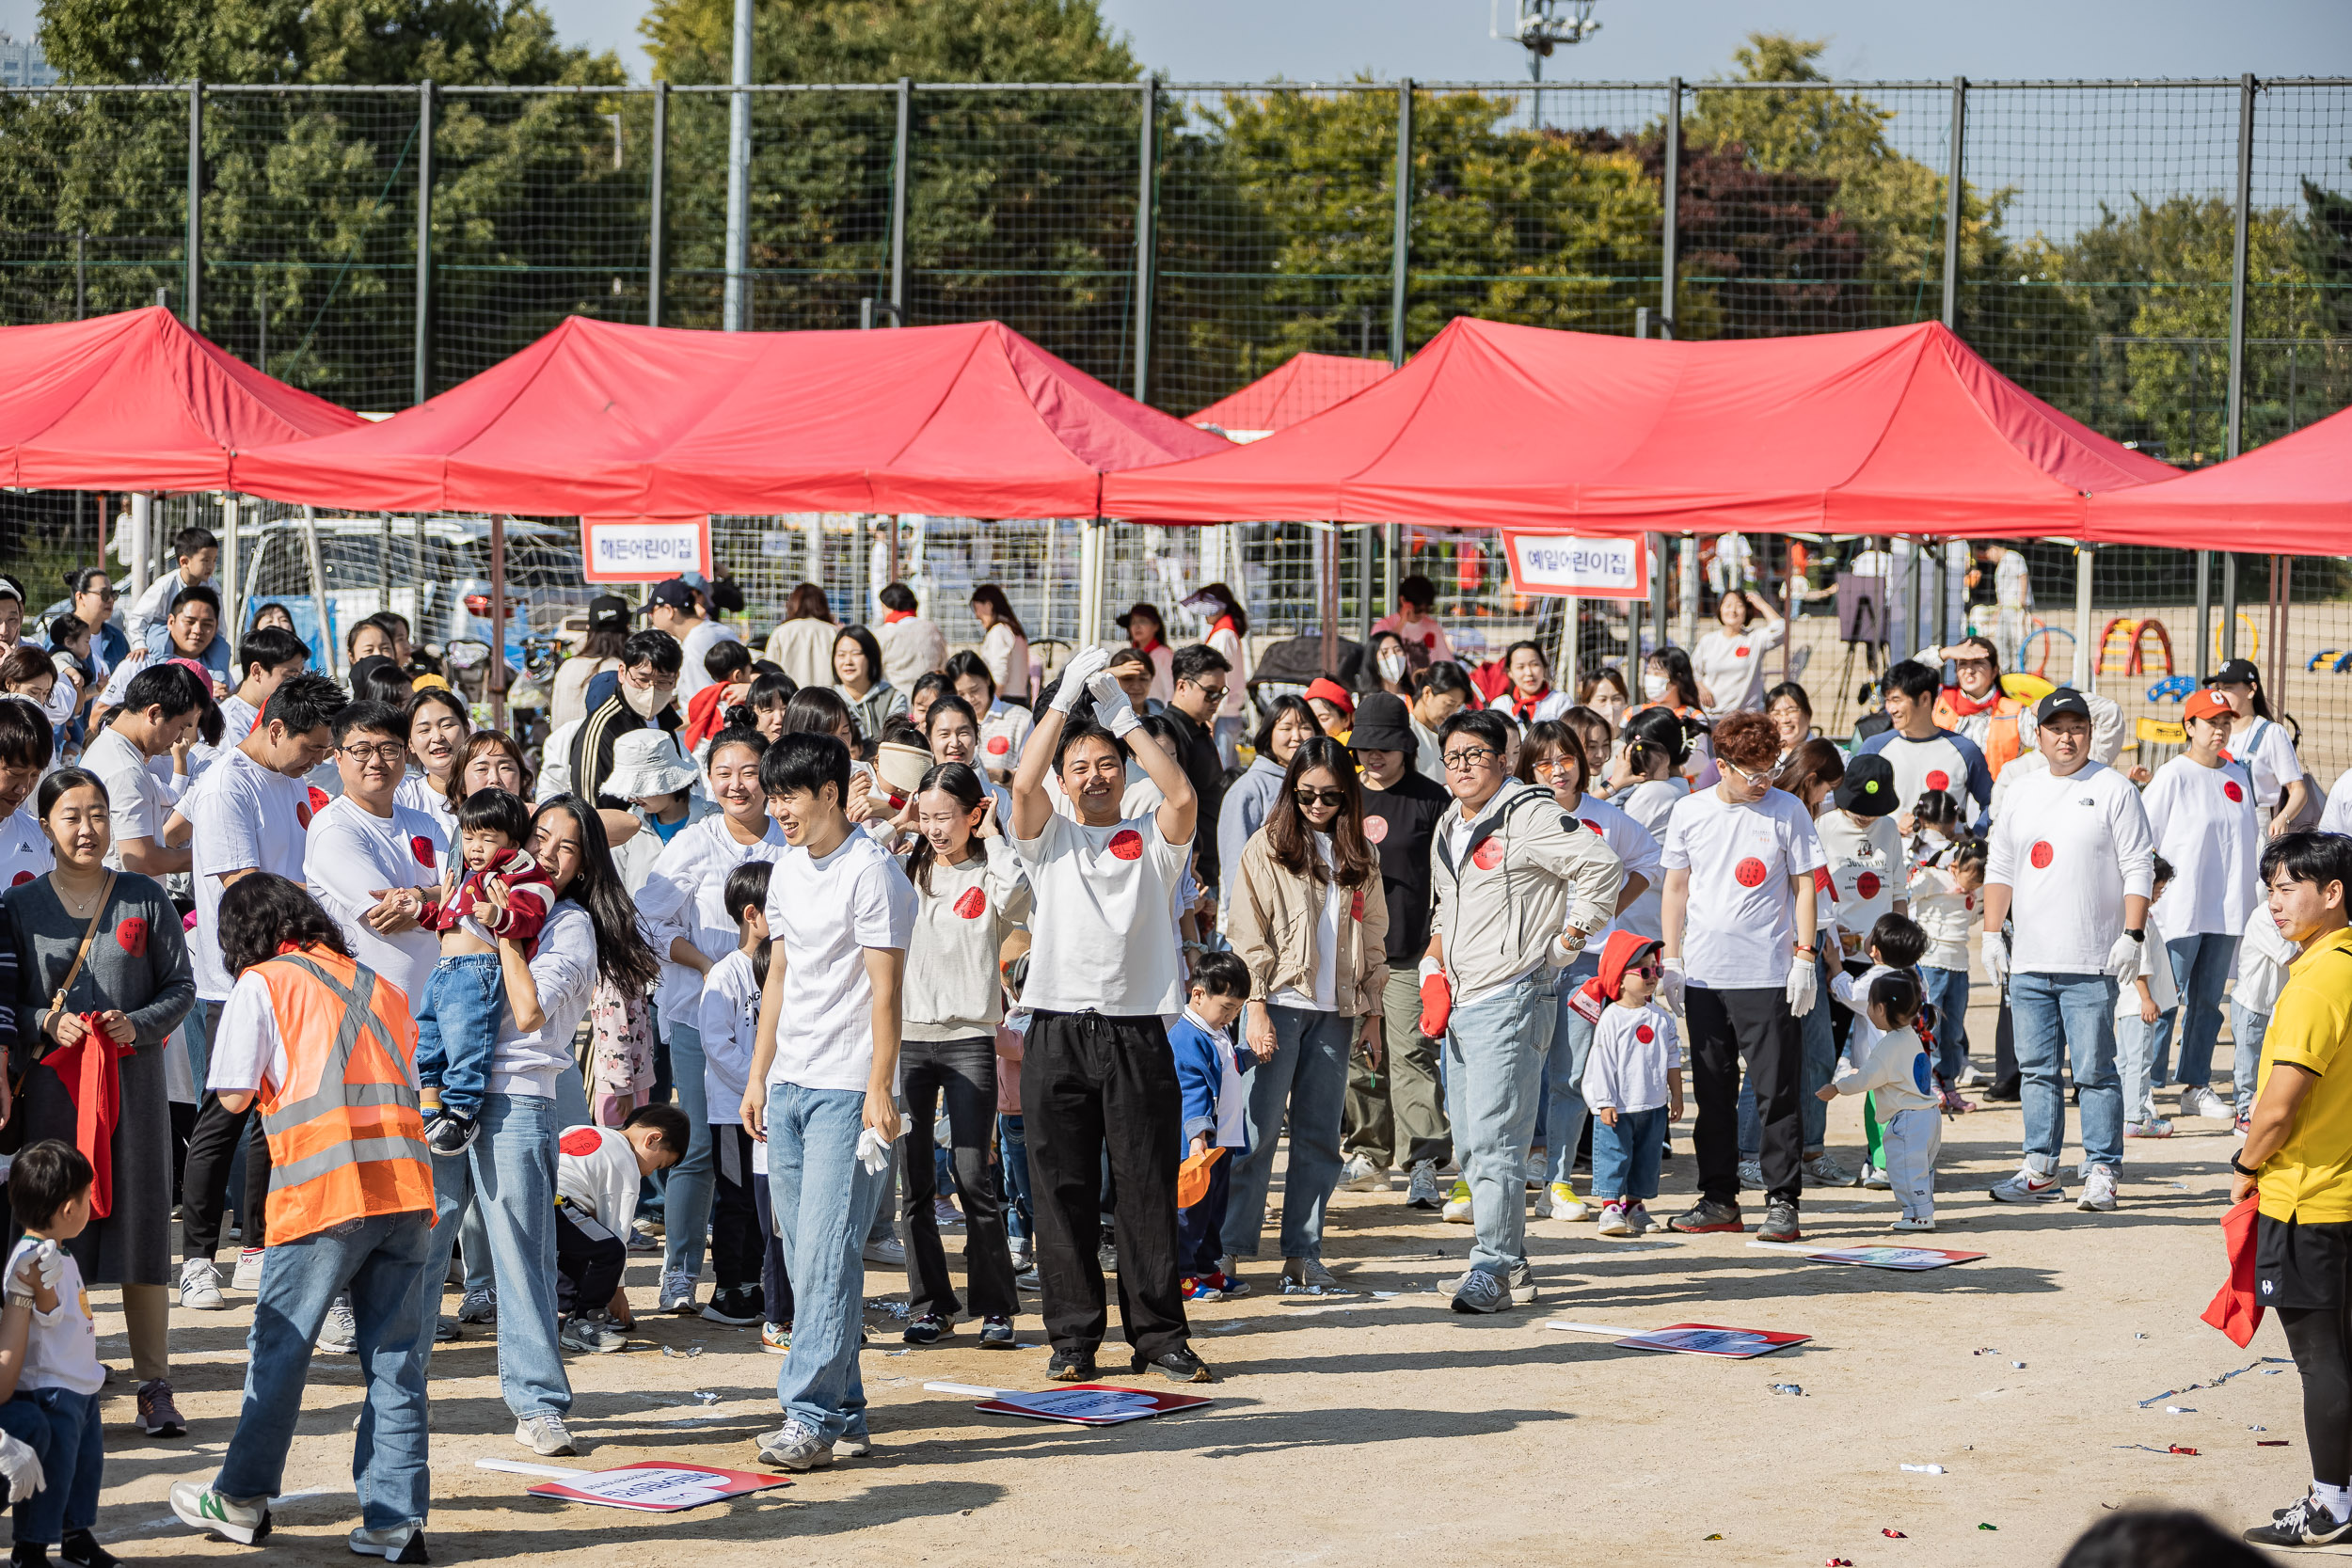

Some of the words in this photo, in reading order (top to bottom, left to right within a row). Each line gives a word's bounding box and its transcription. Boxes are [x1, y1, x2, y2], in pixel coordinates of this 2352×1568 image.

[599, 538, 692, 560] 해든어린이집
[1528, 549, 1627, 575] 예일어린이집
[2210, 691, 2224, 705] C
